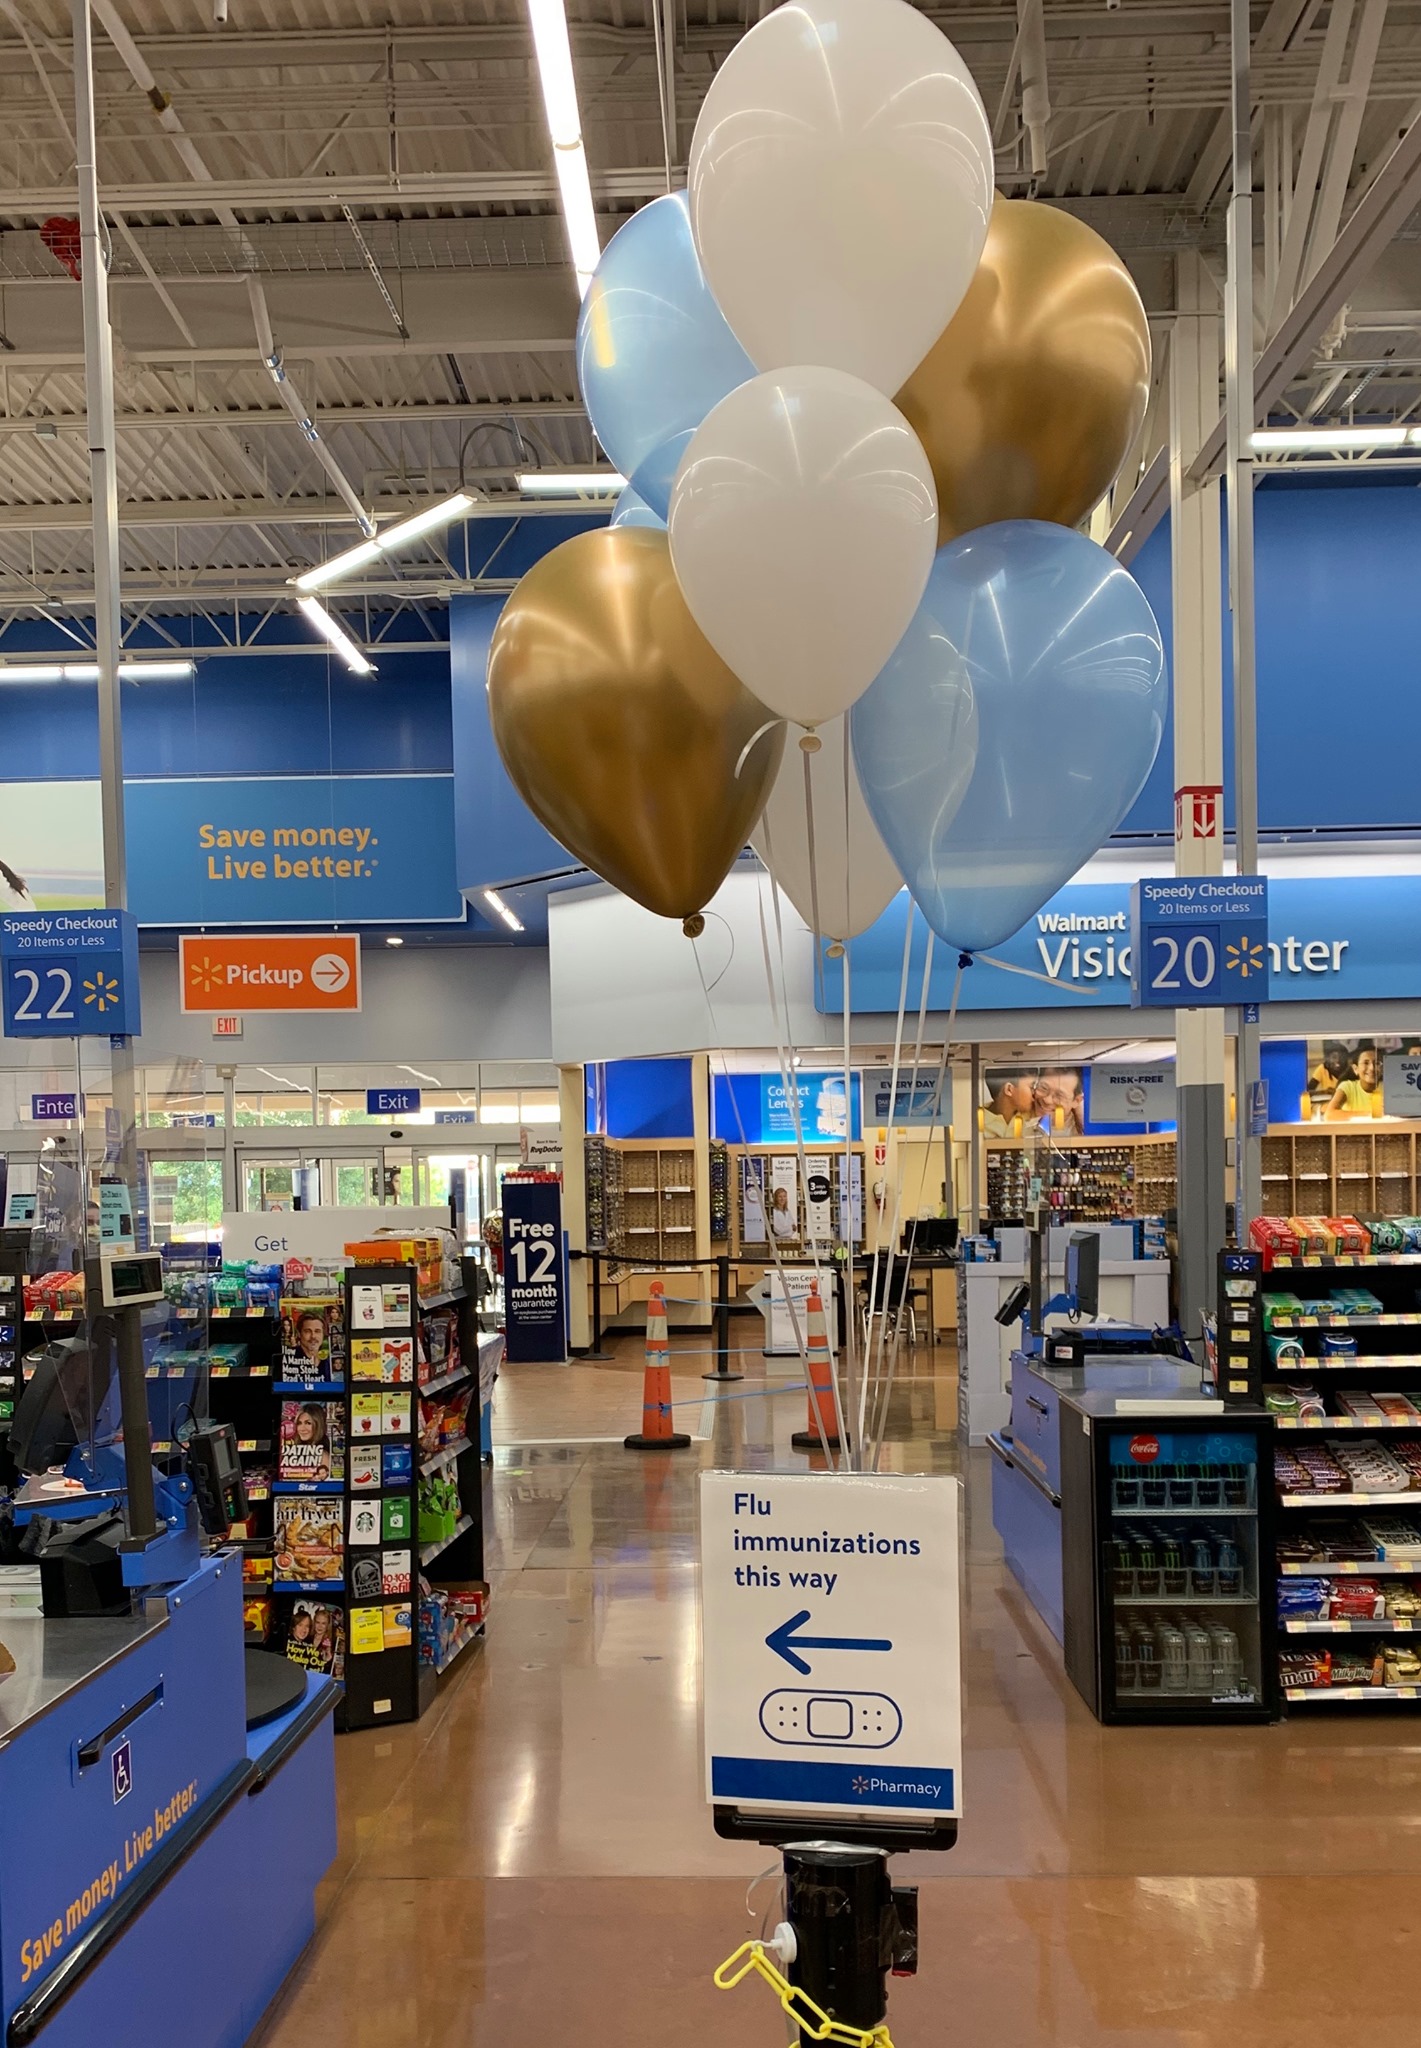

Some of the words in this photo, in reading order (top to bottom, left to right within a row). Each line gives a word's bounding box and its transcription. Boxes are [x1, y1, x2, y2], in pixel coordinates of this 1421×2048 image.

[199, 824, 266, 848] Save
[273, 827, 379, 852] money.
[207, 855, 267, 880] Live
[1144, 884, 1195, 901] Speedy
[1199, 883, 1264, 898] Checkout
[1159, 903, 1173, 915] 20
[1176, 902, 1208, 914] Items
[1210, 904, 1223, 913] or
[1226, 902, 1250, 912] Less
[3, 917, 52, 935] Speedy
[55, 916, 118, 931] Checkout
[1037, 911, 1126, 932] Walmart
[17, 937, 31, 948] 20
[34, 936, 65, 947] Items
[67, 938, 79, 946] or
[81, 935, 105, 946] Less
[1151, 935, 1216, 989] 20
[226, 963, 304, 990] Pickup
[14, 968, 74, 1021] 22
[217, 1017, 238, 1033] EXIT
[1401, 1062, 1421, 1071] SAV
[915, 1080, 936, 1088] DAY
[1109, 1075, 1164, 1084] RISK-FREE
[36, 1099, 75, 1115] Ente
[378, 1094, 409, 1110] Exit
[810, 1182, 816, 1191] 3
[509, 1218, 555, 1238] Free
[254, 1236, 289, 1253] Get
[286, 1263, 313, 1274] HGTV
[510, 1240, 557, 1283] 12
[511, 1284, 557, 1298] month
[281, 1345, 297, 1356] How
[282, 1357, 288, 1365] A
[288, 1355, 315, 1366] Married
[282, 1365, 299, 1375] Mom
[300, 1365, 319, 1375] Stole
[282, 1374, 303, 1383] Brad's
[304, 1374, 325, 1383] Heart
[304, 1383, 315, 1391] Us
[282, 1444, 324, 1456] DATING
[280, 1456, 323, 1467] AGAIN!
[298, 1483, 318, 1491] Star
[734, 1493, 771, 1516] Flu
[276, 1507, 298, 1521] air
[302, 1506, 340, 1524] fryer
[733, 1529, 921, 1556] immunizations
[356, 1582, 380, 1592] TACO
[382, 1582, 411, 1594] Refill
[734, 1565, 781, 1588] this
[788, 1572, 838, 1596] way
[358, 1588, 380, 1598] BELL
[286, 1644, 306, 1655] How
[307, 1646, 320, 1657] We
[287, 1652, 309, 1665] Make
[309, 1656, 327, 1667] Our
[870, 1778, 942, 1799] Pharmacy
[20, 1917, 63, 1983] Save
[66, 1859, 122, 1937] money.
[124, 1825, 153, 1874] Live
